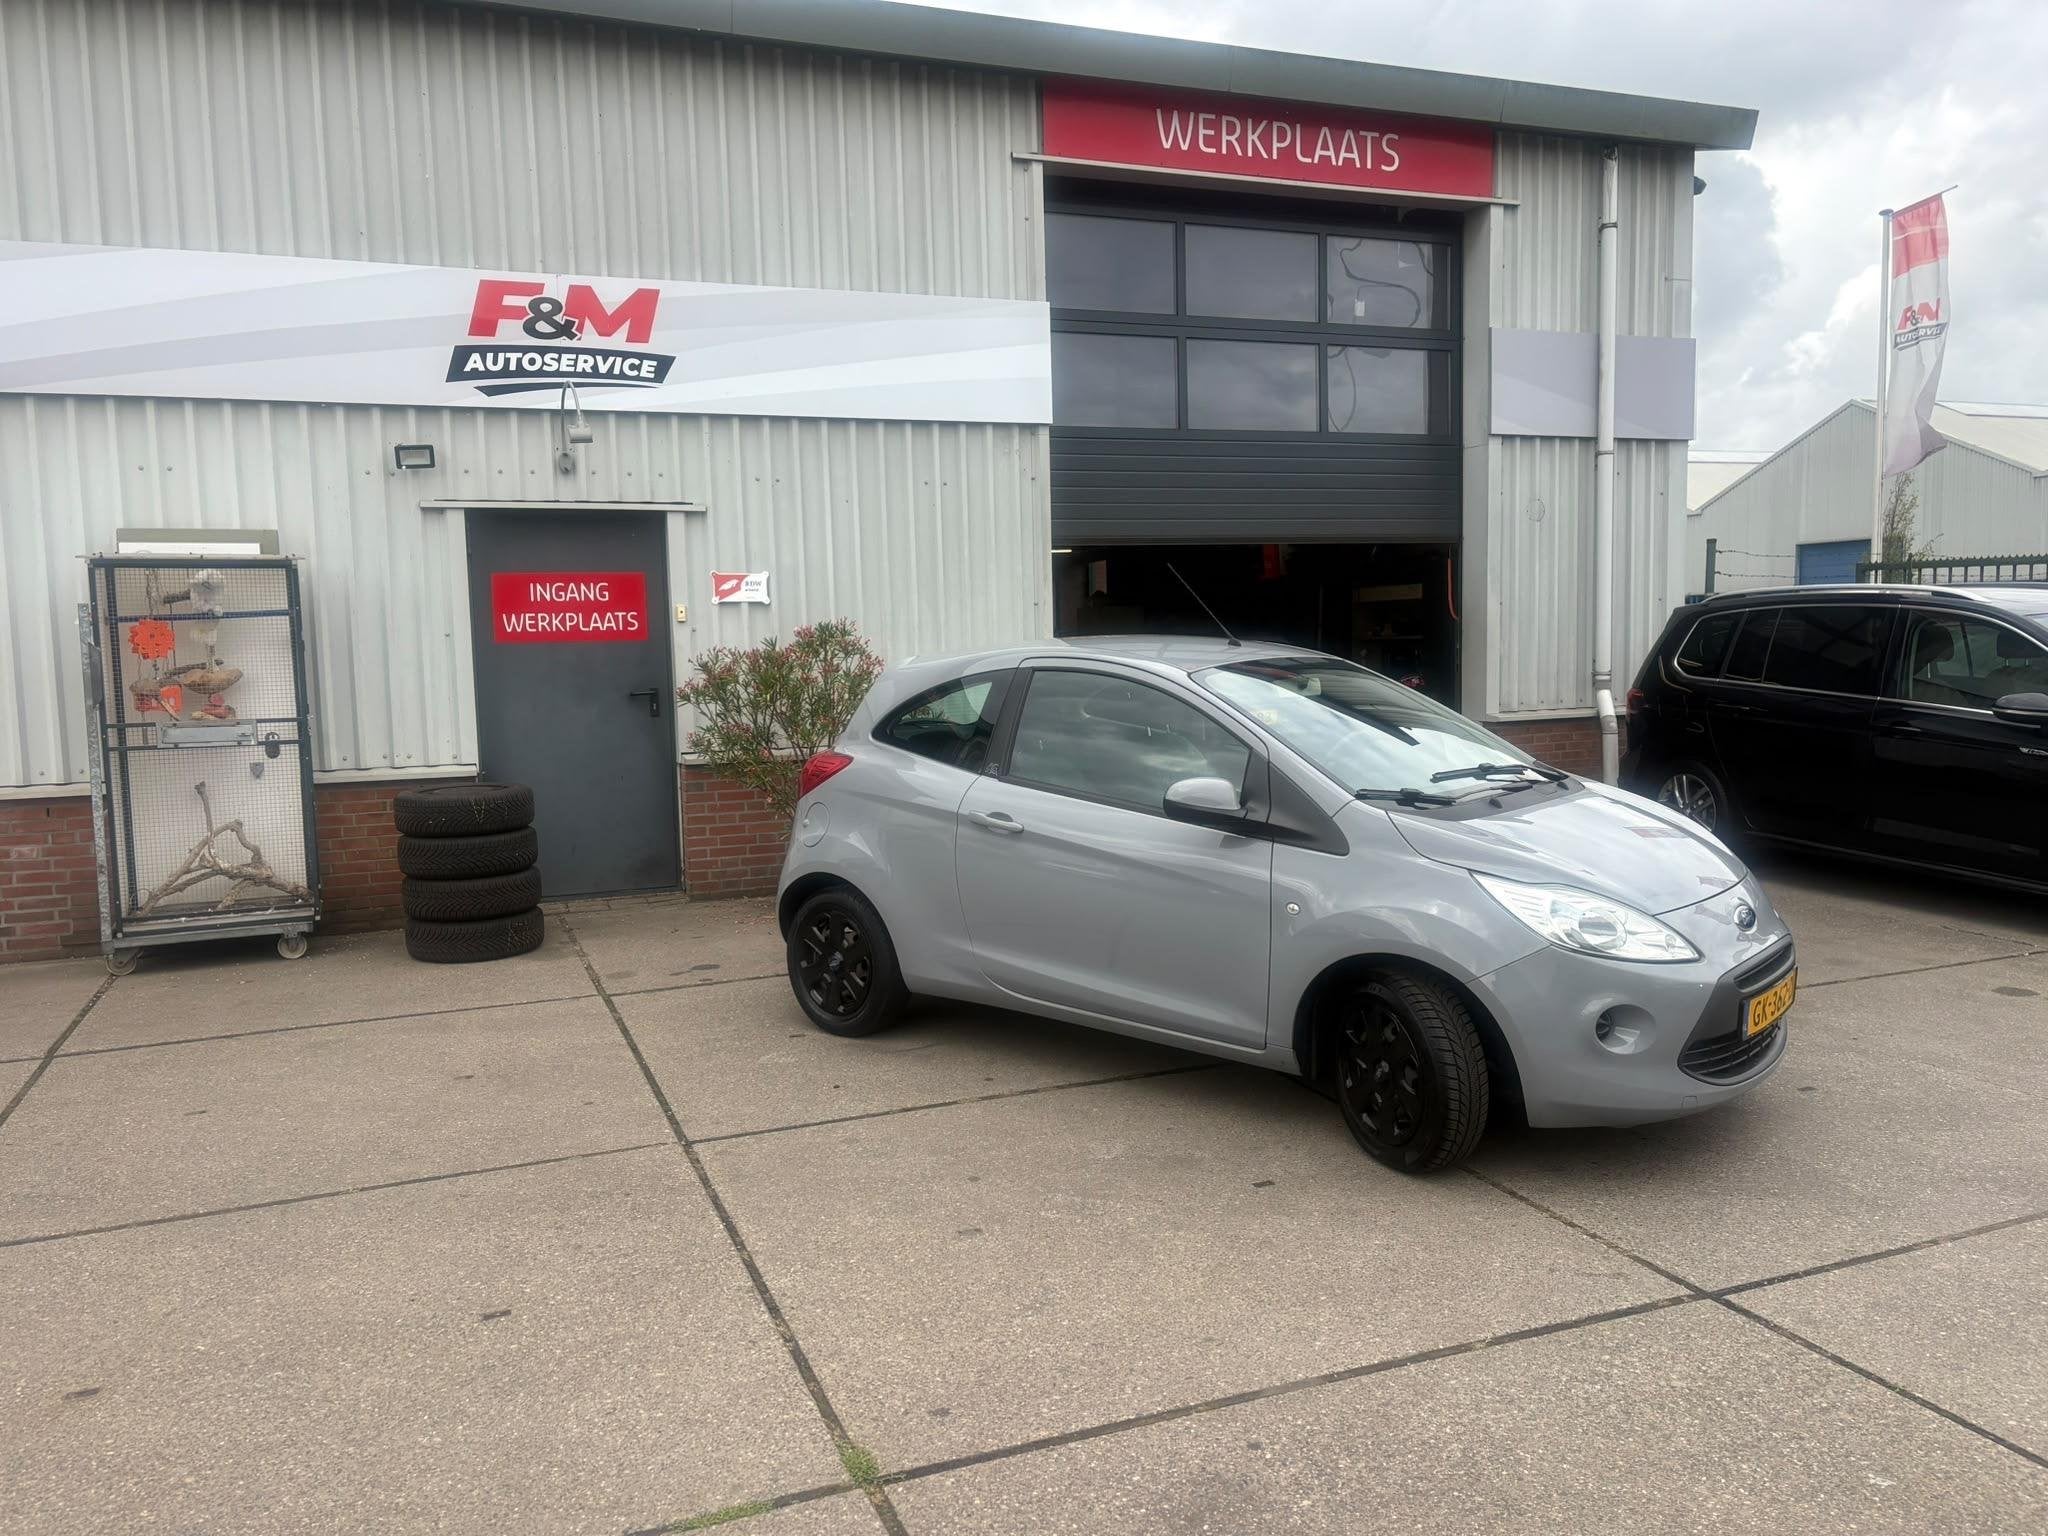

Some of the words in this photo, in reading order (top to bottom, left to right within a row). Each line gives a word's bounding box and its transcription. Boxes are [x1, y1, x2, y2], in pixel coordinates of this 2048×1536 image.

[1156, 108, 1400, 172] WERKPLAATS
[467, 279, 661, 344] F&M
[463, 352, 658, 378] AUTOSERVICE
[529, 582, 609, 602] INGANG
[502, 611, 639, 633] WERKPLAATS
